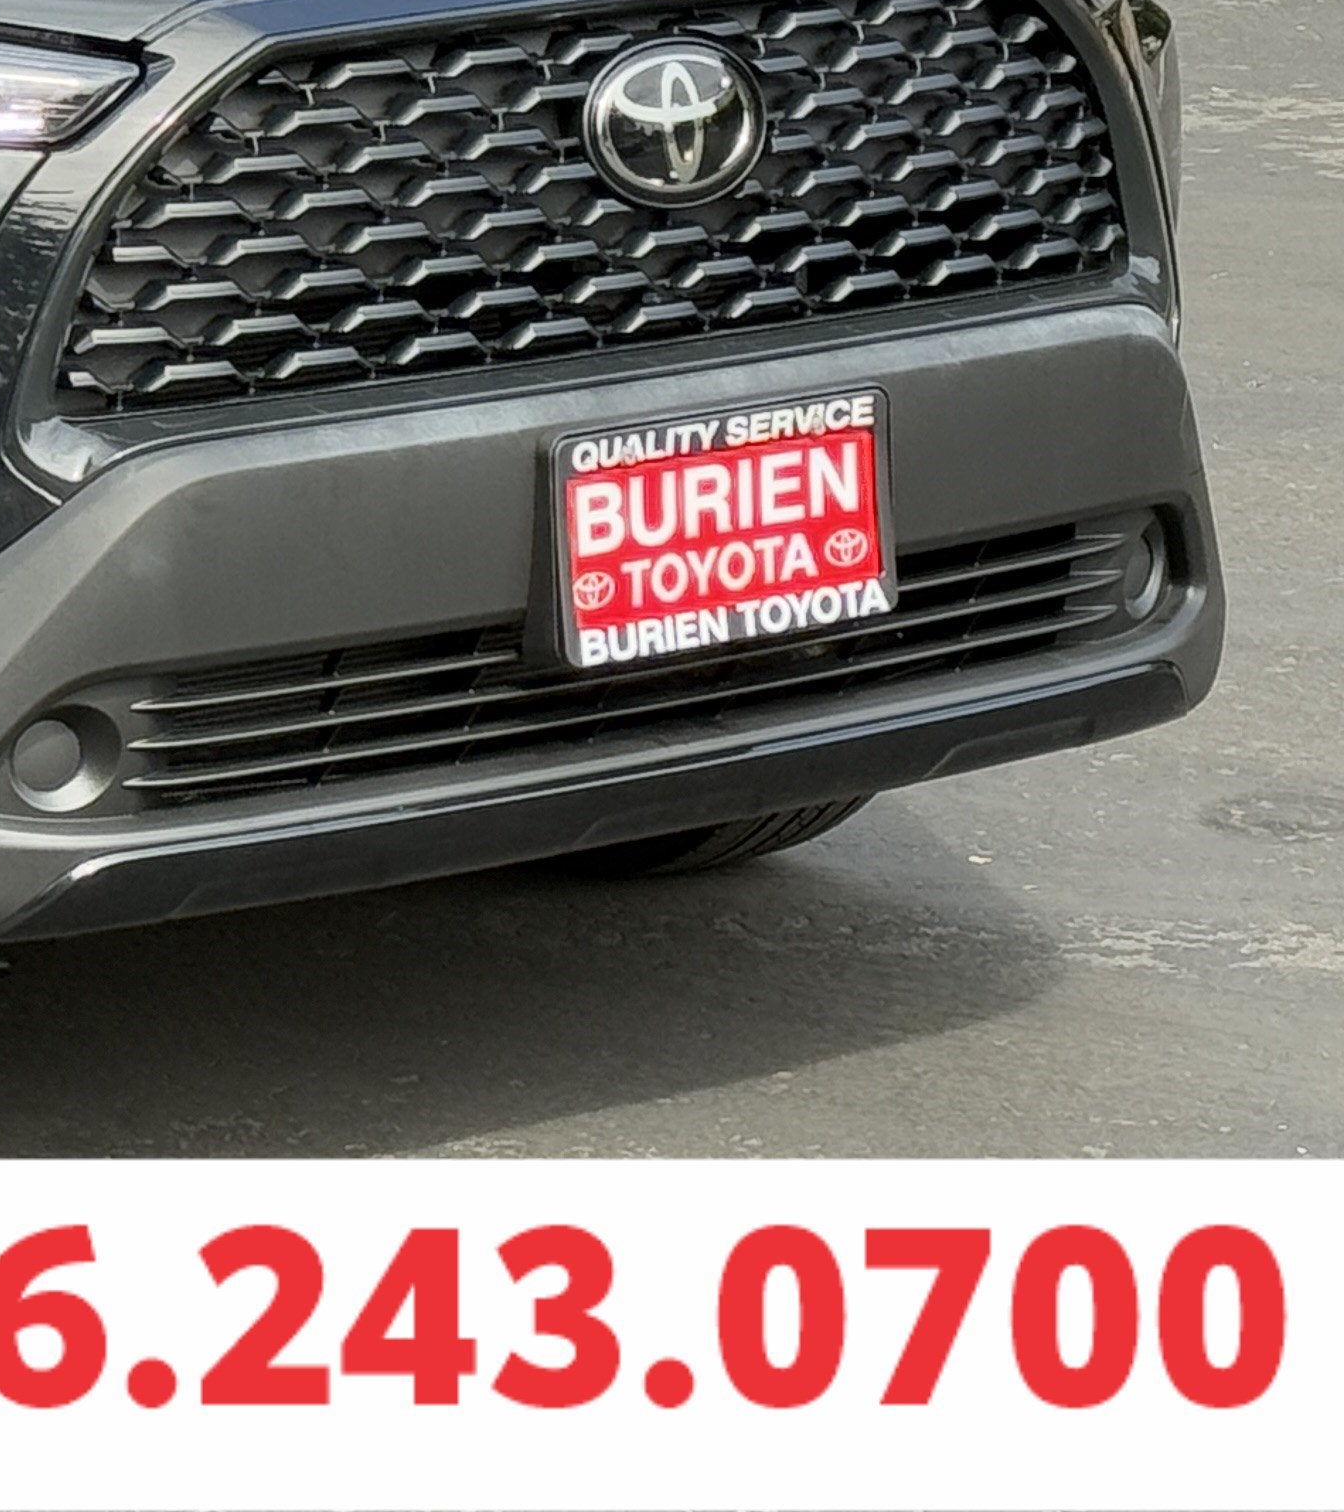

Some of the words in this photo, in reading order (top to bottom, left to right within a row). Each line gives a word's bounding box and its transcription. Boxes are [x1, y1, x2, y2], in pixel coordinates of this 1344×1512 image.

[571, 419, 722, 473] QUALITY
[726, 395, 875, 447] SERVICE
[575, 441, 861, 559] BURIEN
[620, 532, 819, 608] TOYOTA
[578, 605, 730, 668] BURIEN
[736, 577, 892, 641] TOYOTA
